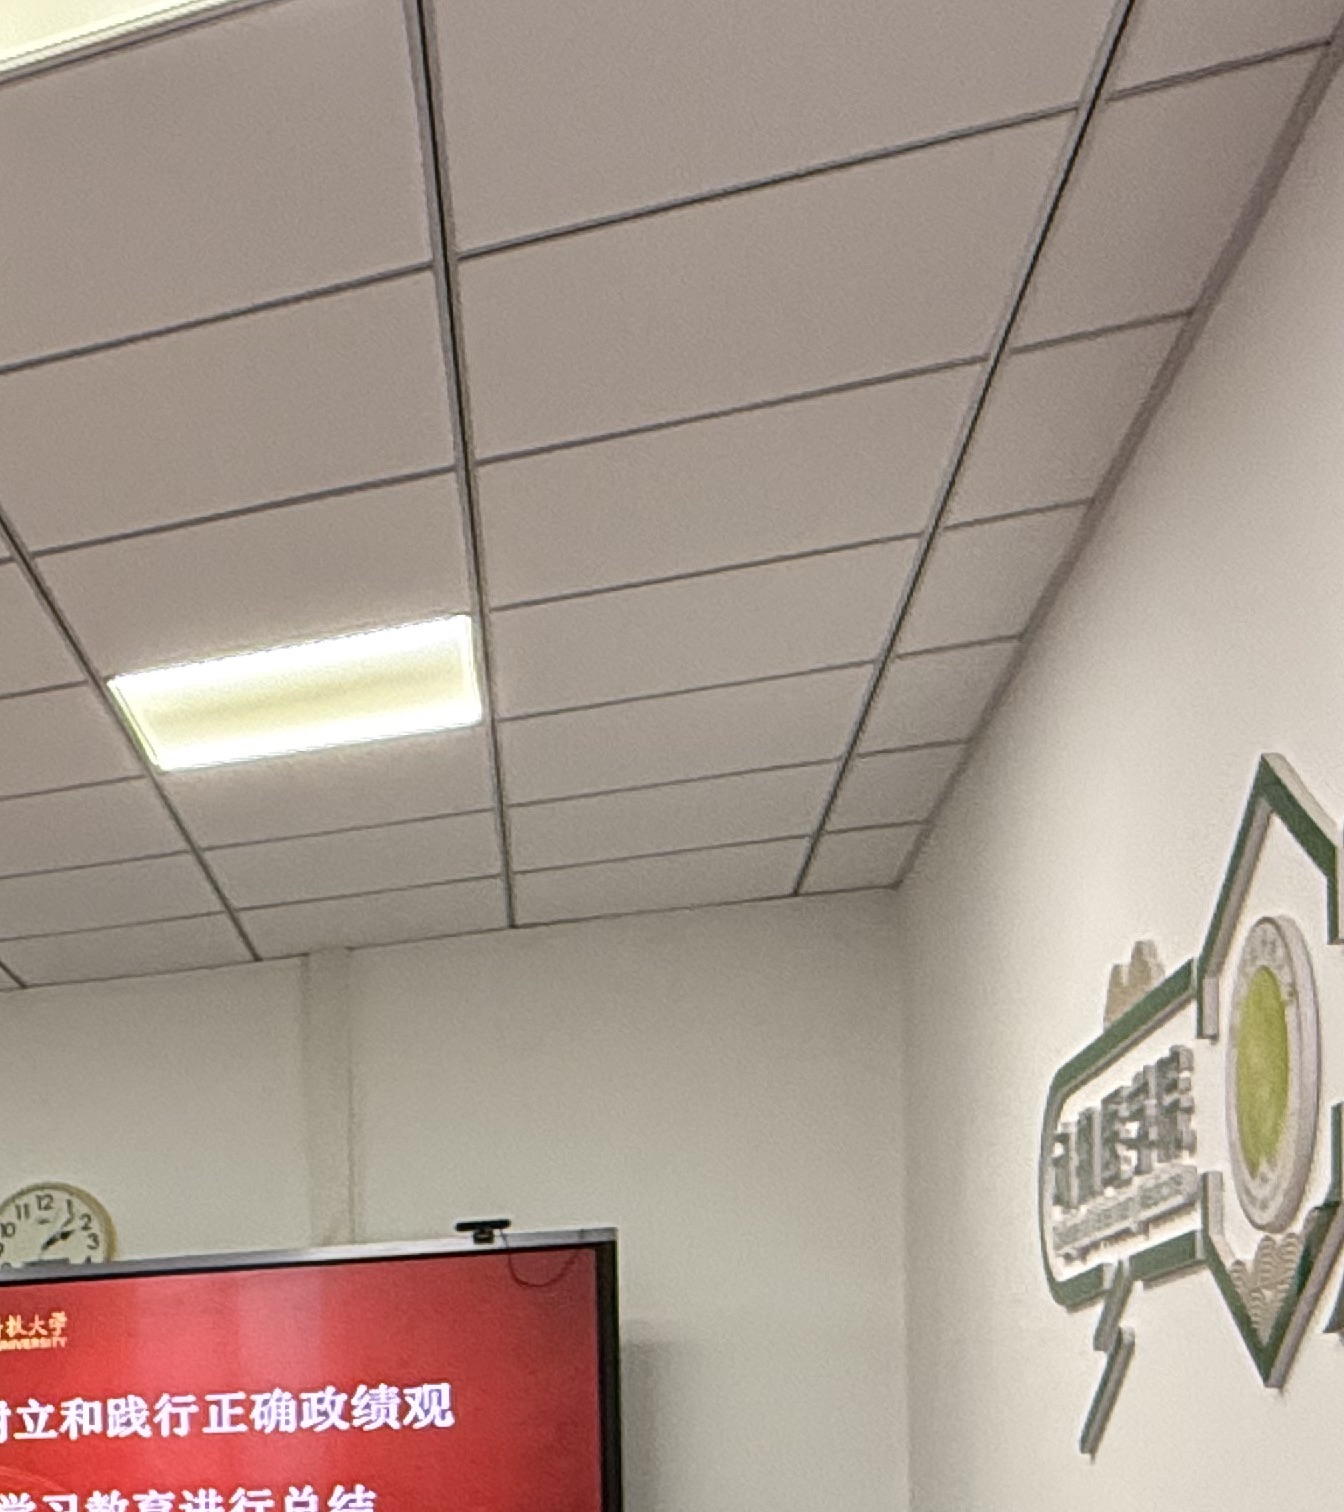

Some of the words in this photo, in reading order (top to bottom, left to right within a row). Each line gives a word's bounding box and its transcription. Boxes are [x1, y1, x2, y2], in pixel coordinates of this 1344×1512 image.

[35, 1194, 54, 1211] 12
[15, 1203, 30, 1220] 11
[0, 1223, 16, 1238] 10
[80, 1213, 92, 1231] 2
[87, 1232, 99, 1250] 3
